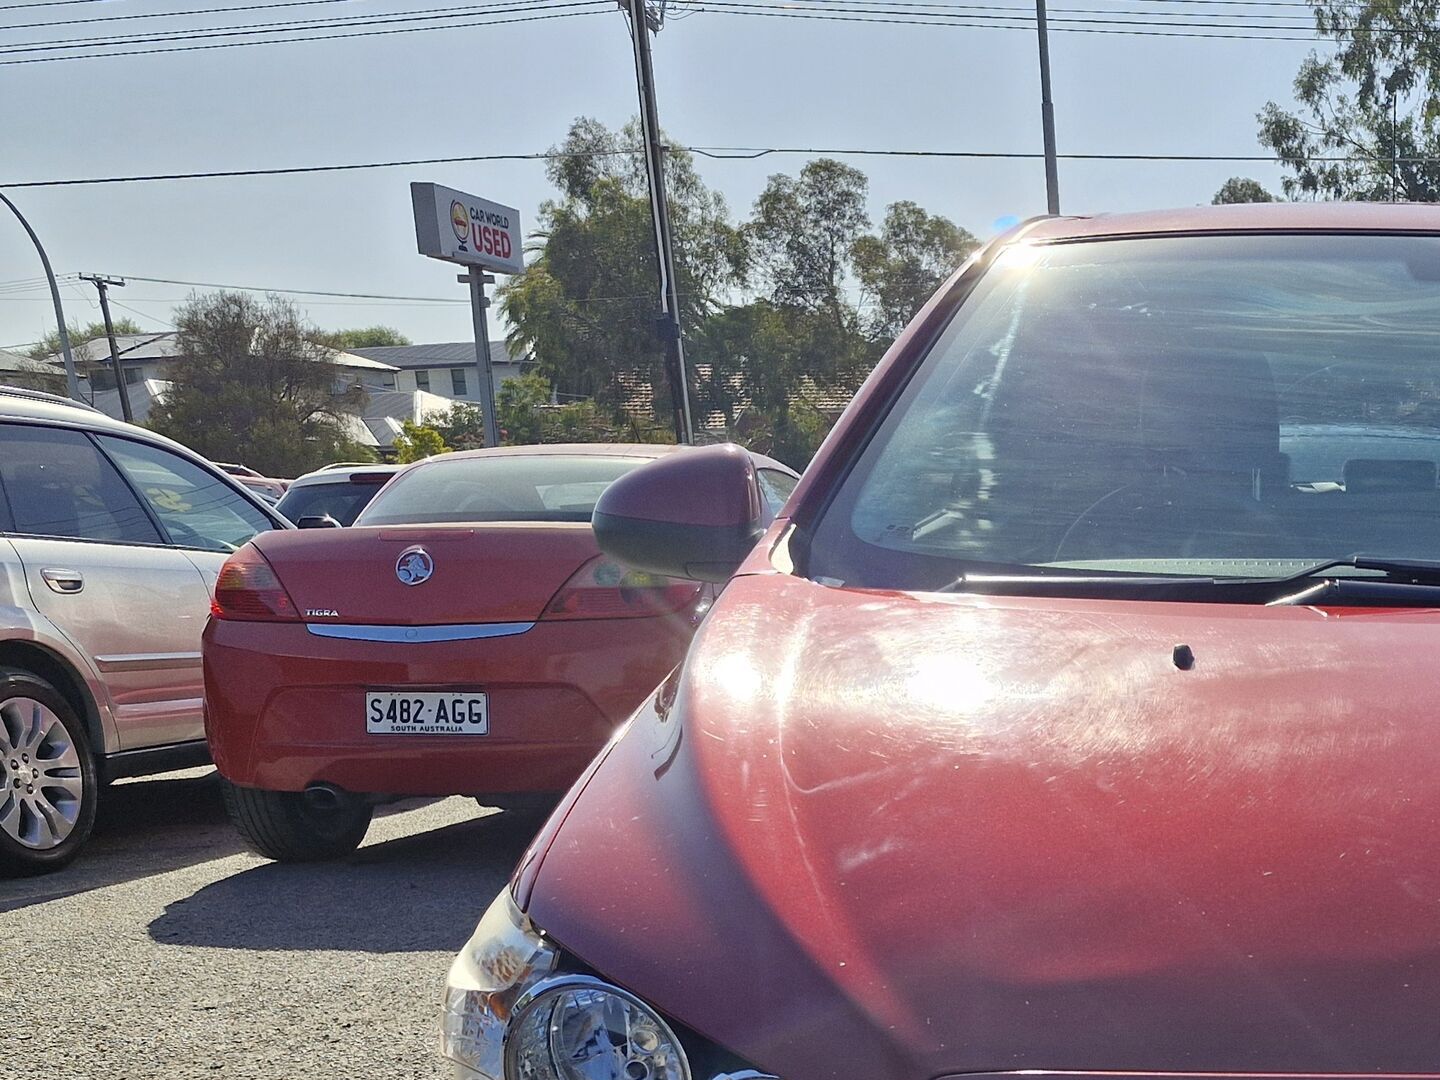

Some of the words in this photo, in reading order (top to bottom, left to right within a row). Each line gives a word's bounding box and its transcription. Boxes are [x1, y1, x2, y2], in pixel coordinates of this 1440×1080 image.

[470, 207, 485, 222] CAR
[485, 211, 509, 229] WORLD
[471, 222, 512, 259] USED
[305, 608, 340, 617] TIGRA
